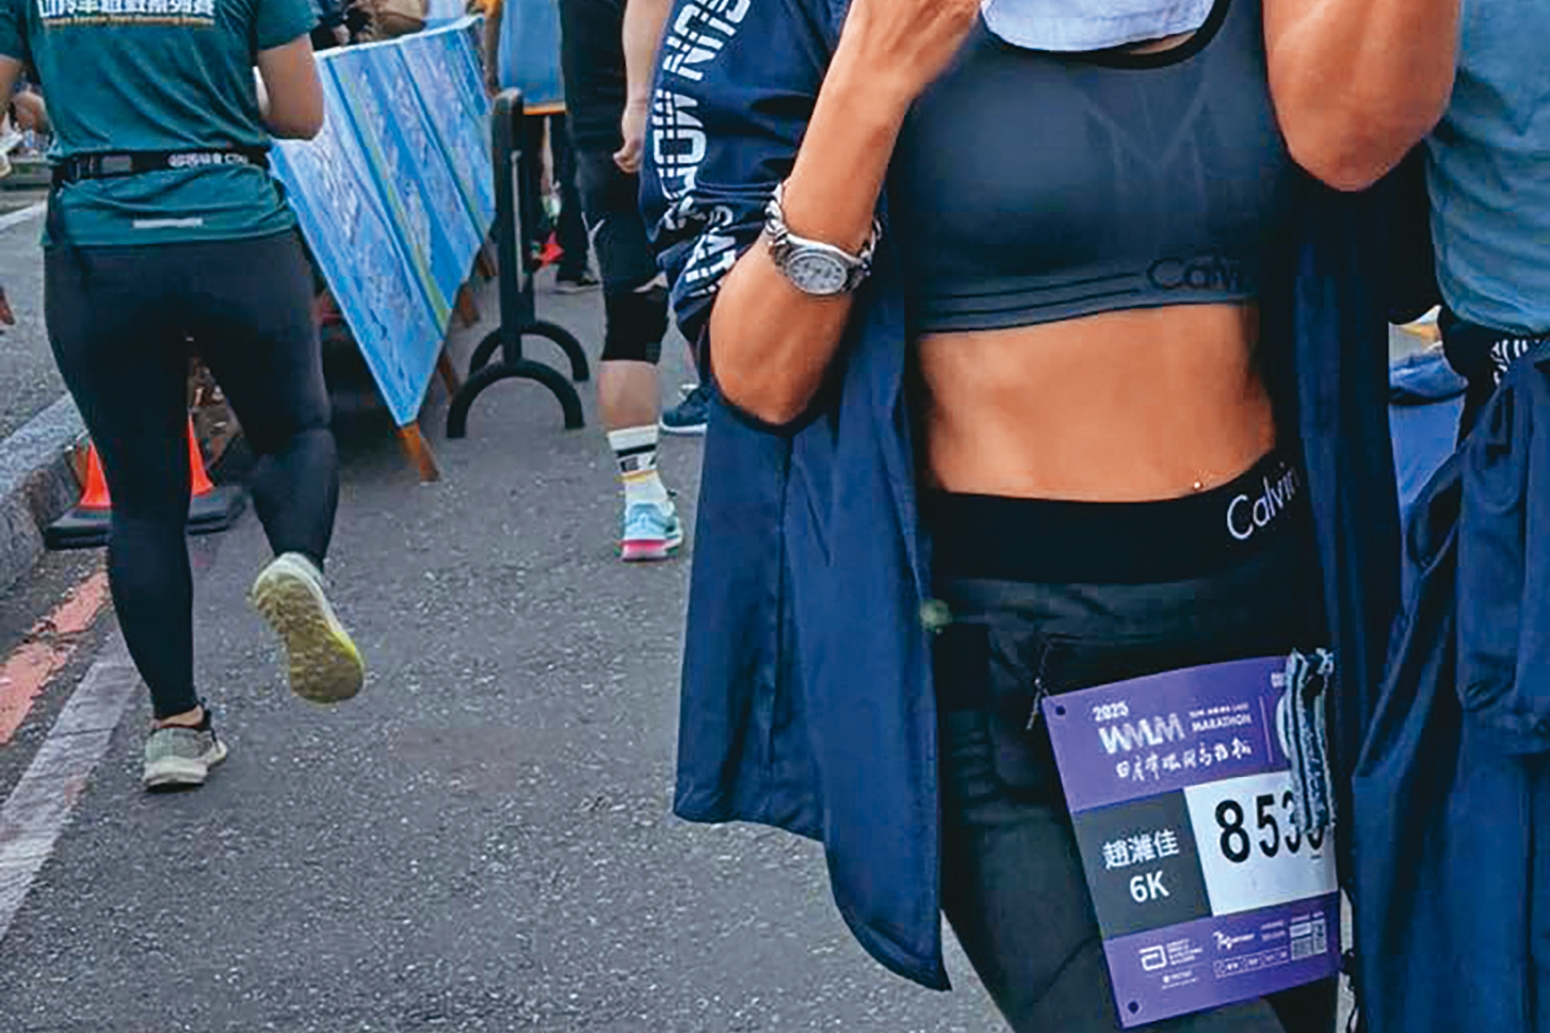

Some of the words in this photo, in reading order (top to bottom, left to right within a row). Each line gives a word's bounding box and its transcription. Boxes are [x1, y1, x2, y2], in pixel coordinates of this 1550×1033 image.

[1092, 700, 1130, 722] 2025
[1191, 713, 1253, 733] MARATHON
[1129, 870, 1171, 904] 6K
